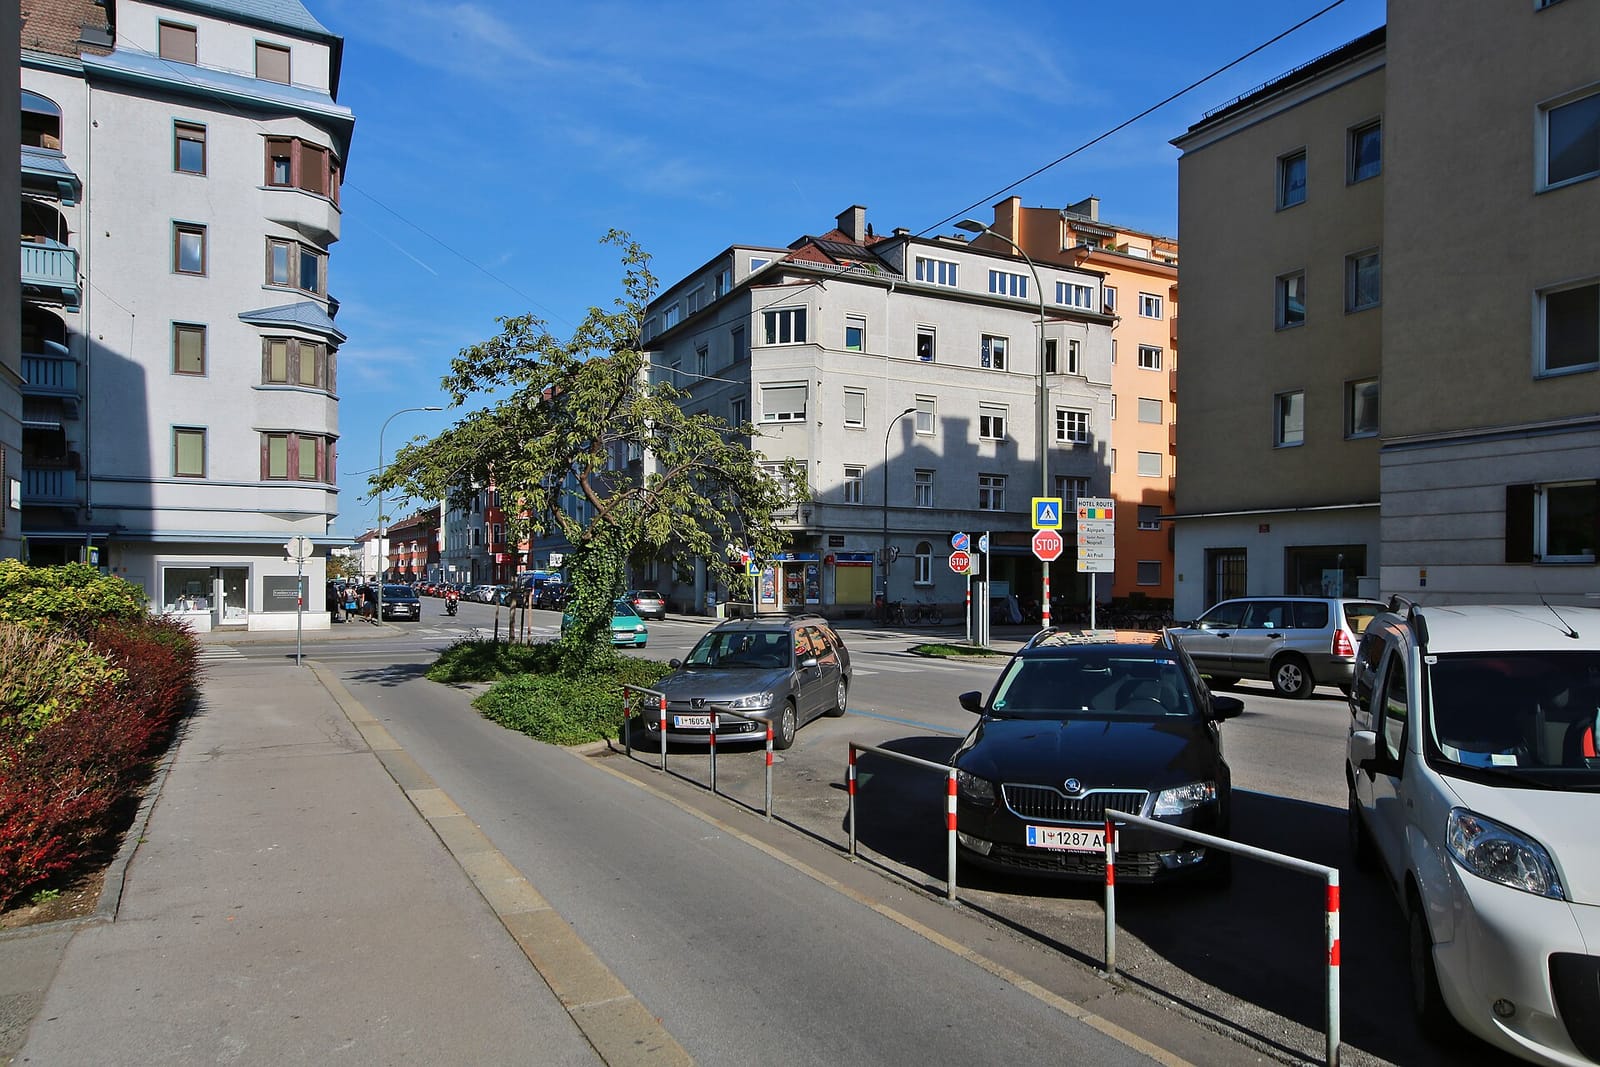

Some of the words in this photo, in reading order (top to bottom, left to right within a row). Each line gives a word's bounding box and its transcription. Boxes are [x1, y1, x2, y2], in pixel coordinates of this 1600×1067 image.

[1036, 539, 1059, 550] STOP
[1042, 831, 1046, 843] I
[1057, 832, 1088, 846] 1287
